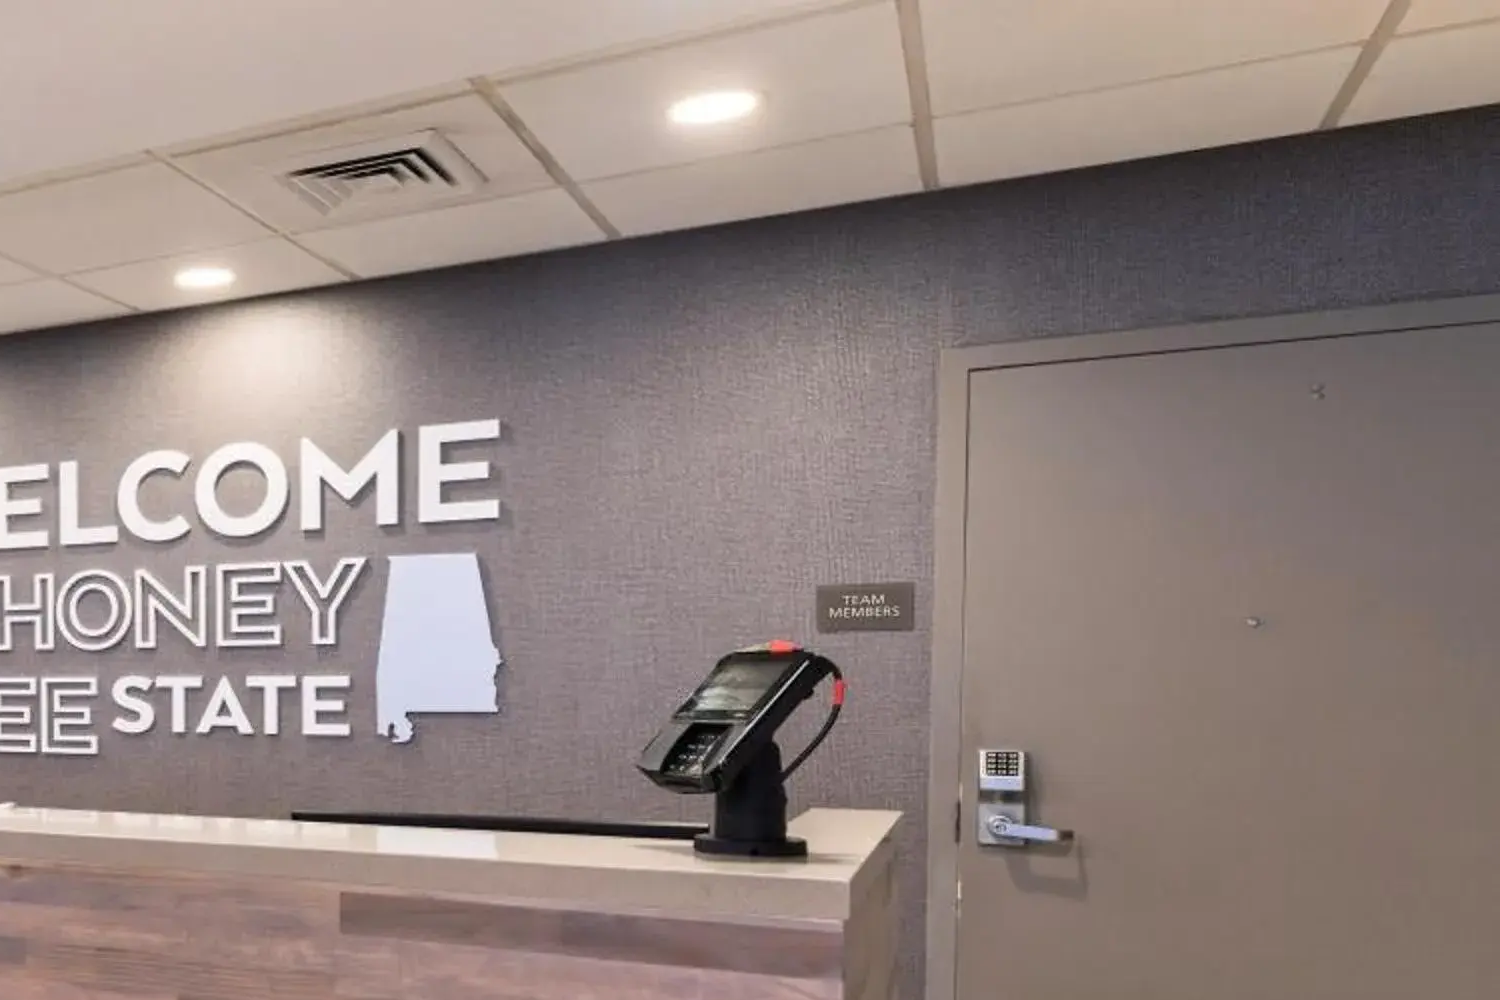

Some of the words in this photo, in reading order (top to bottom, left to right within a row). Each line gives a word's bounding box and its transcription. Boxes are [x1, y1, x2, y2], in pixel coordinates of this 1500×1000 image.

[841, 594, 885, 605] TEAM
[829, 605, 900, 618] MEMBERS
[111, 674, 351, 736] STATE
